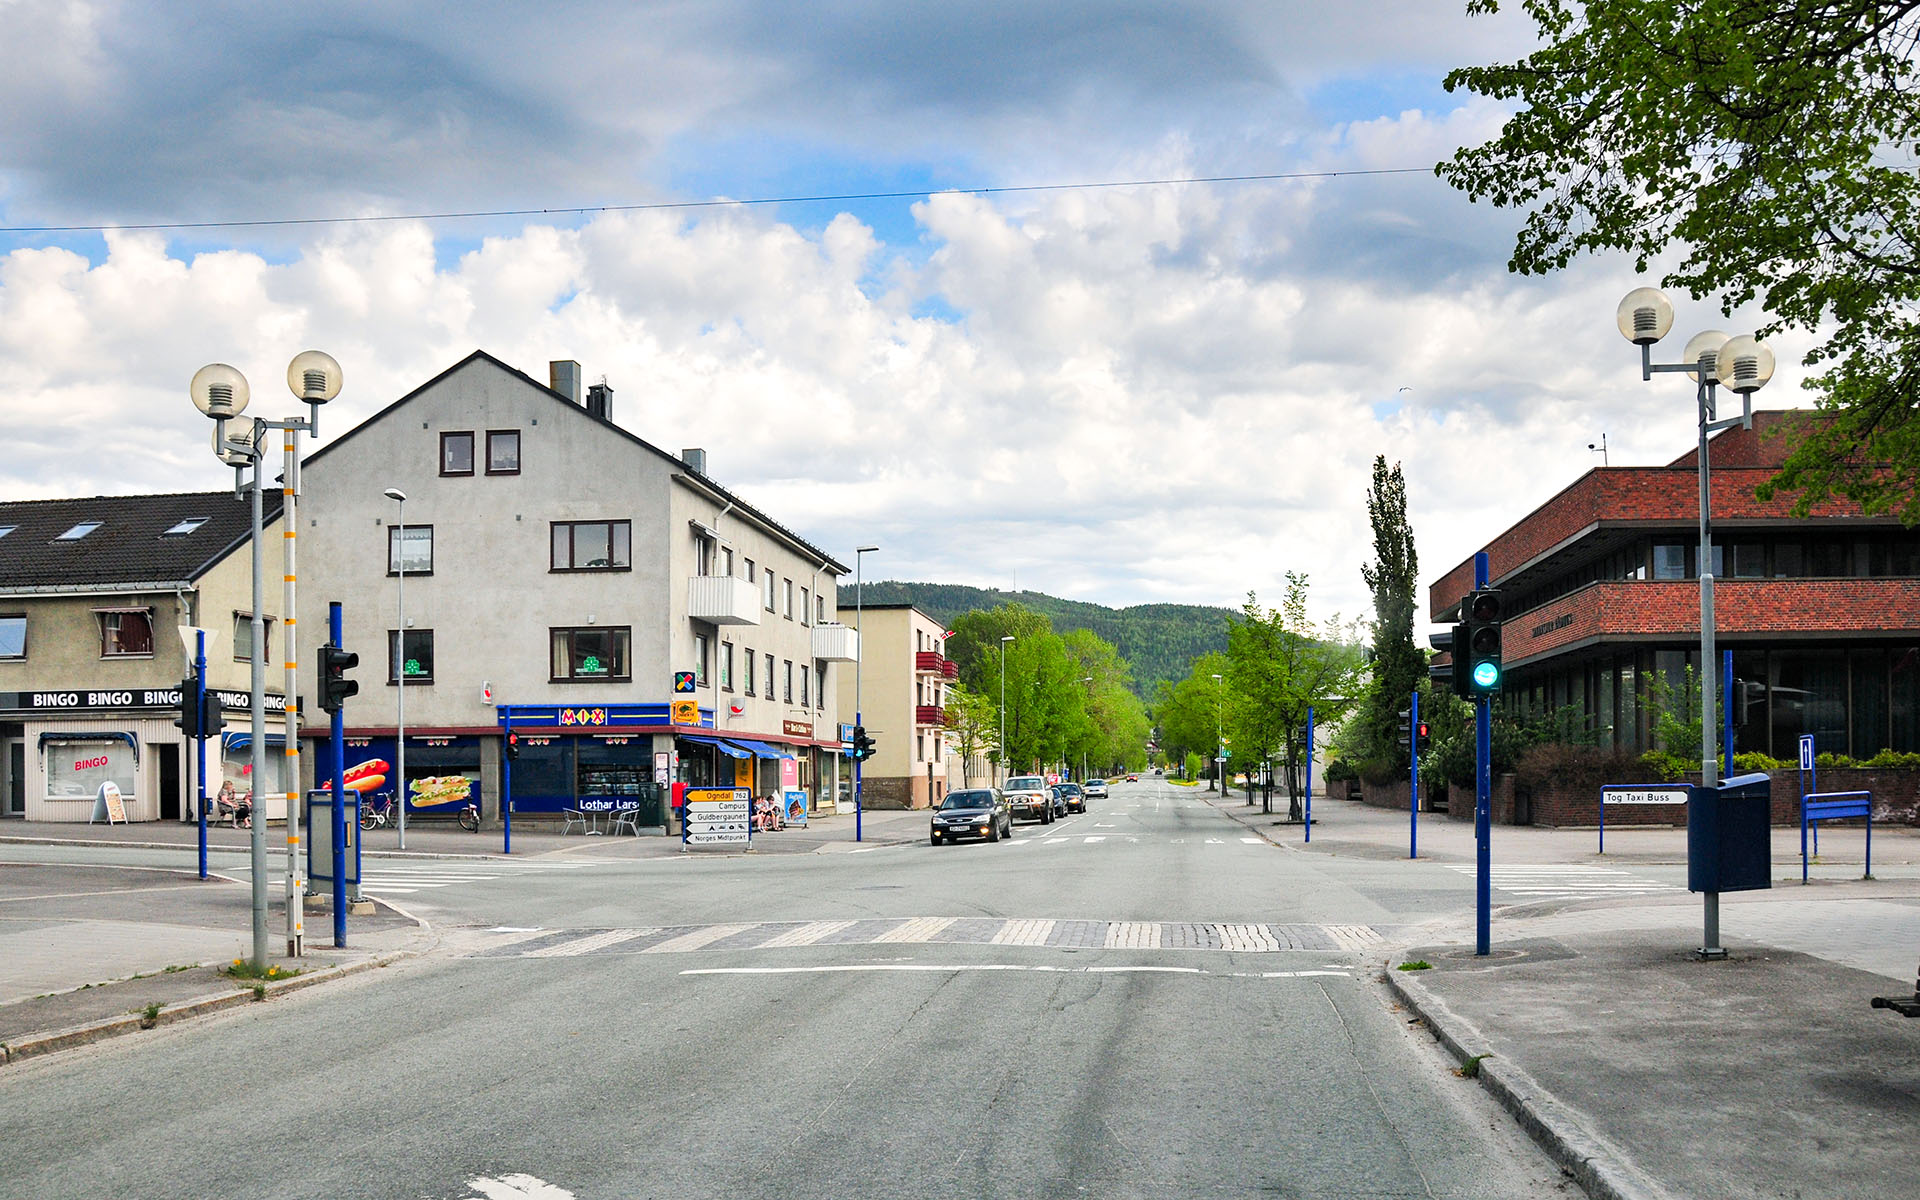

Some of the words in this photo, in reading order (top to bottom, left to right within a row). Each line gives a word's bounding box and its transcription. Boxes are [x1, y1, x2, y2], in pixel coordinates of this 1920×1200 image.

[33, 693, 79, 707] BINGO
[88, 692, 133, 706] BINGO
[144, 691, 183, 704] BING
[562, 709, 605, 724] MIX
[74, 756, 108, 771] BINGO
[580, 800, 613, 810] Lothar
[1607, 793, 1622, 804] Tog
[1626, 793, 1644, 802] Taxi
[1647, 793, 1670, 802] Buss
[697, 813, 746, 821] Guldbergaunet
